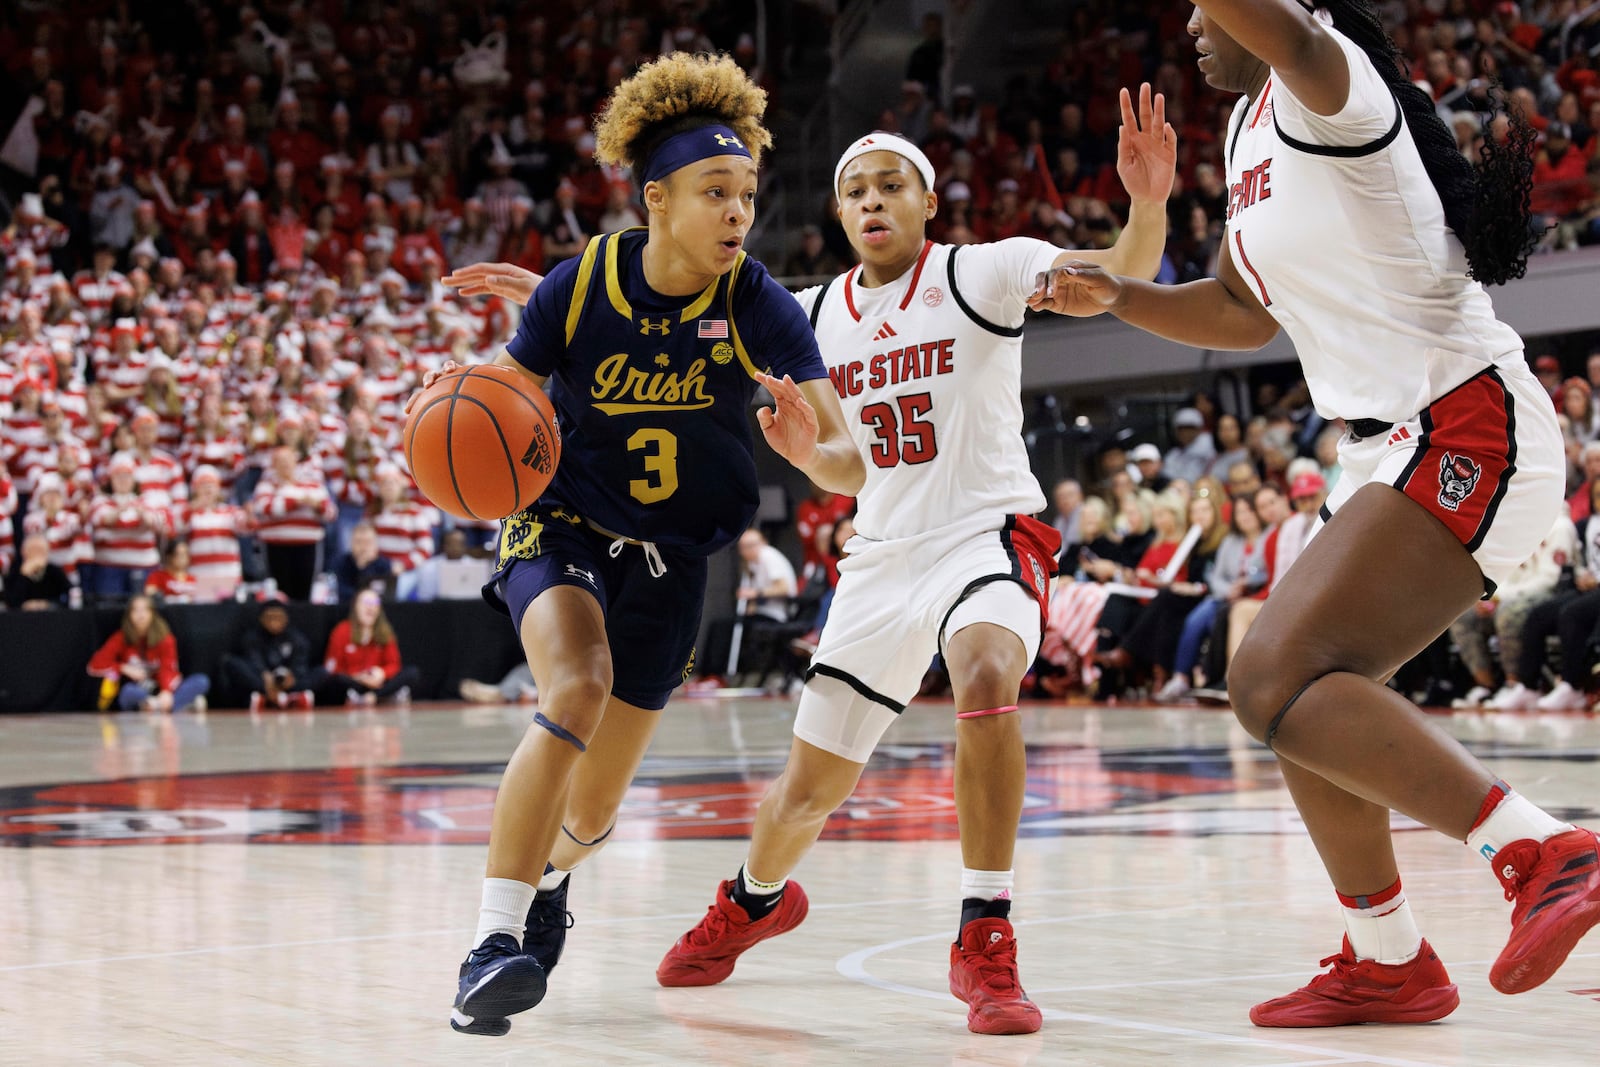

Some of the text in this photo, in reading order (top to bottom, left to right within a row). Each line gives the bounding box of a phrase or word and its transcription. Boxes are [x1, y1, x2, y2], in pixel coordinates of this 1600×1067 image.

[1235, 230, 1272, 307] 1
[591, 353, 715, 416] Irish
[829, 338, 956, 399] NC STATE
[533, 423, 552, 475] adidas
[860, 391, 938, 468] 35
[626, 428, 679, 504] 3
